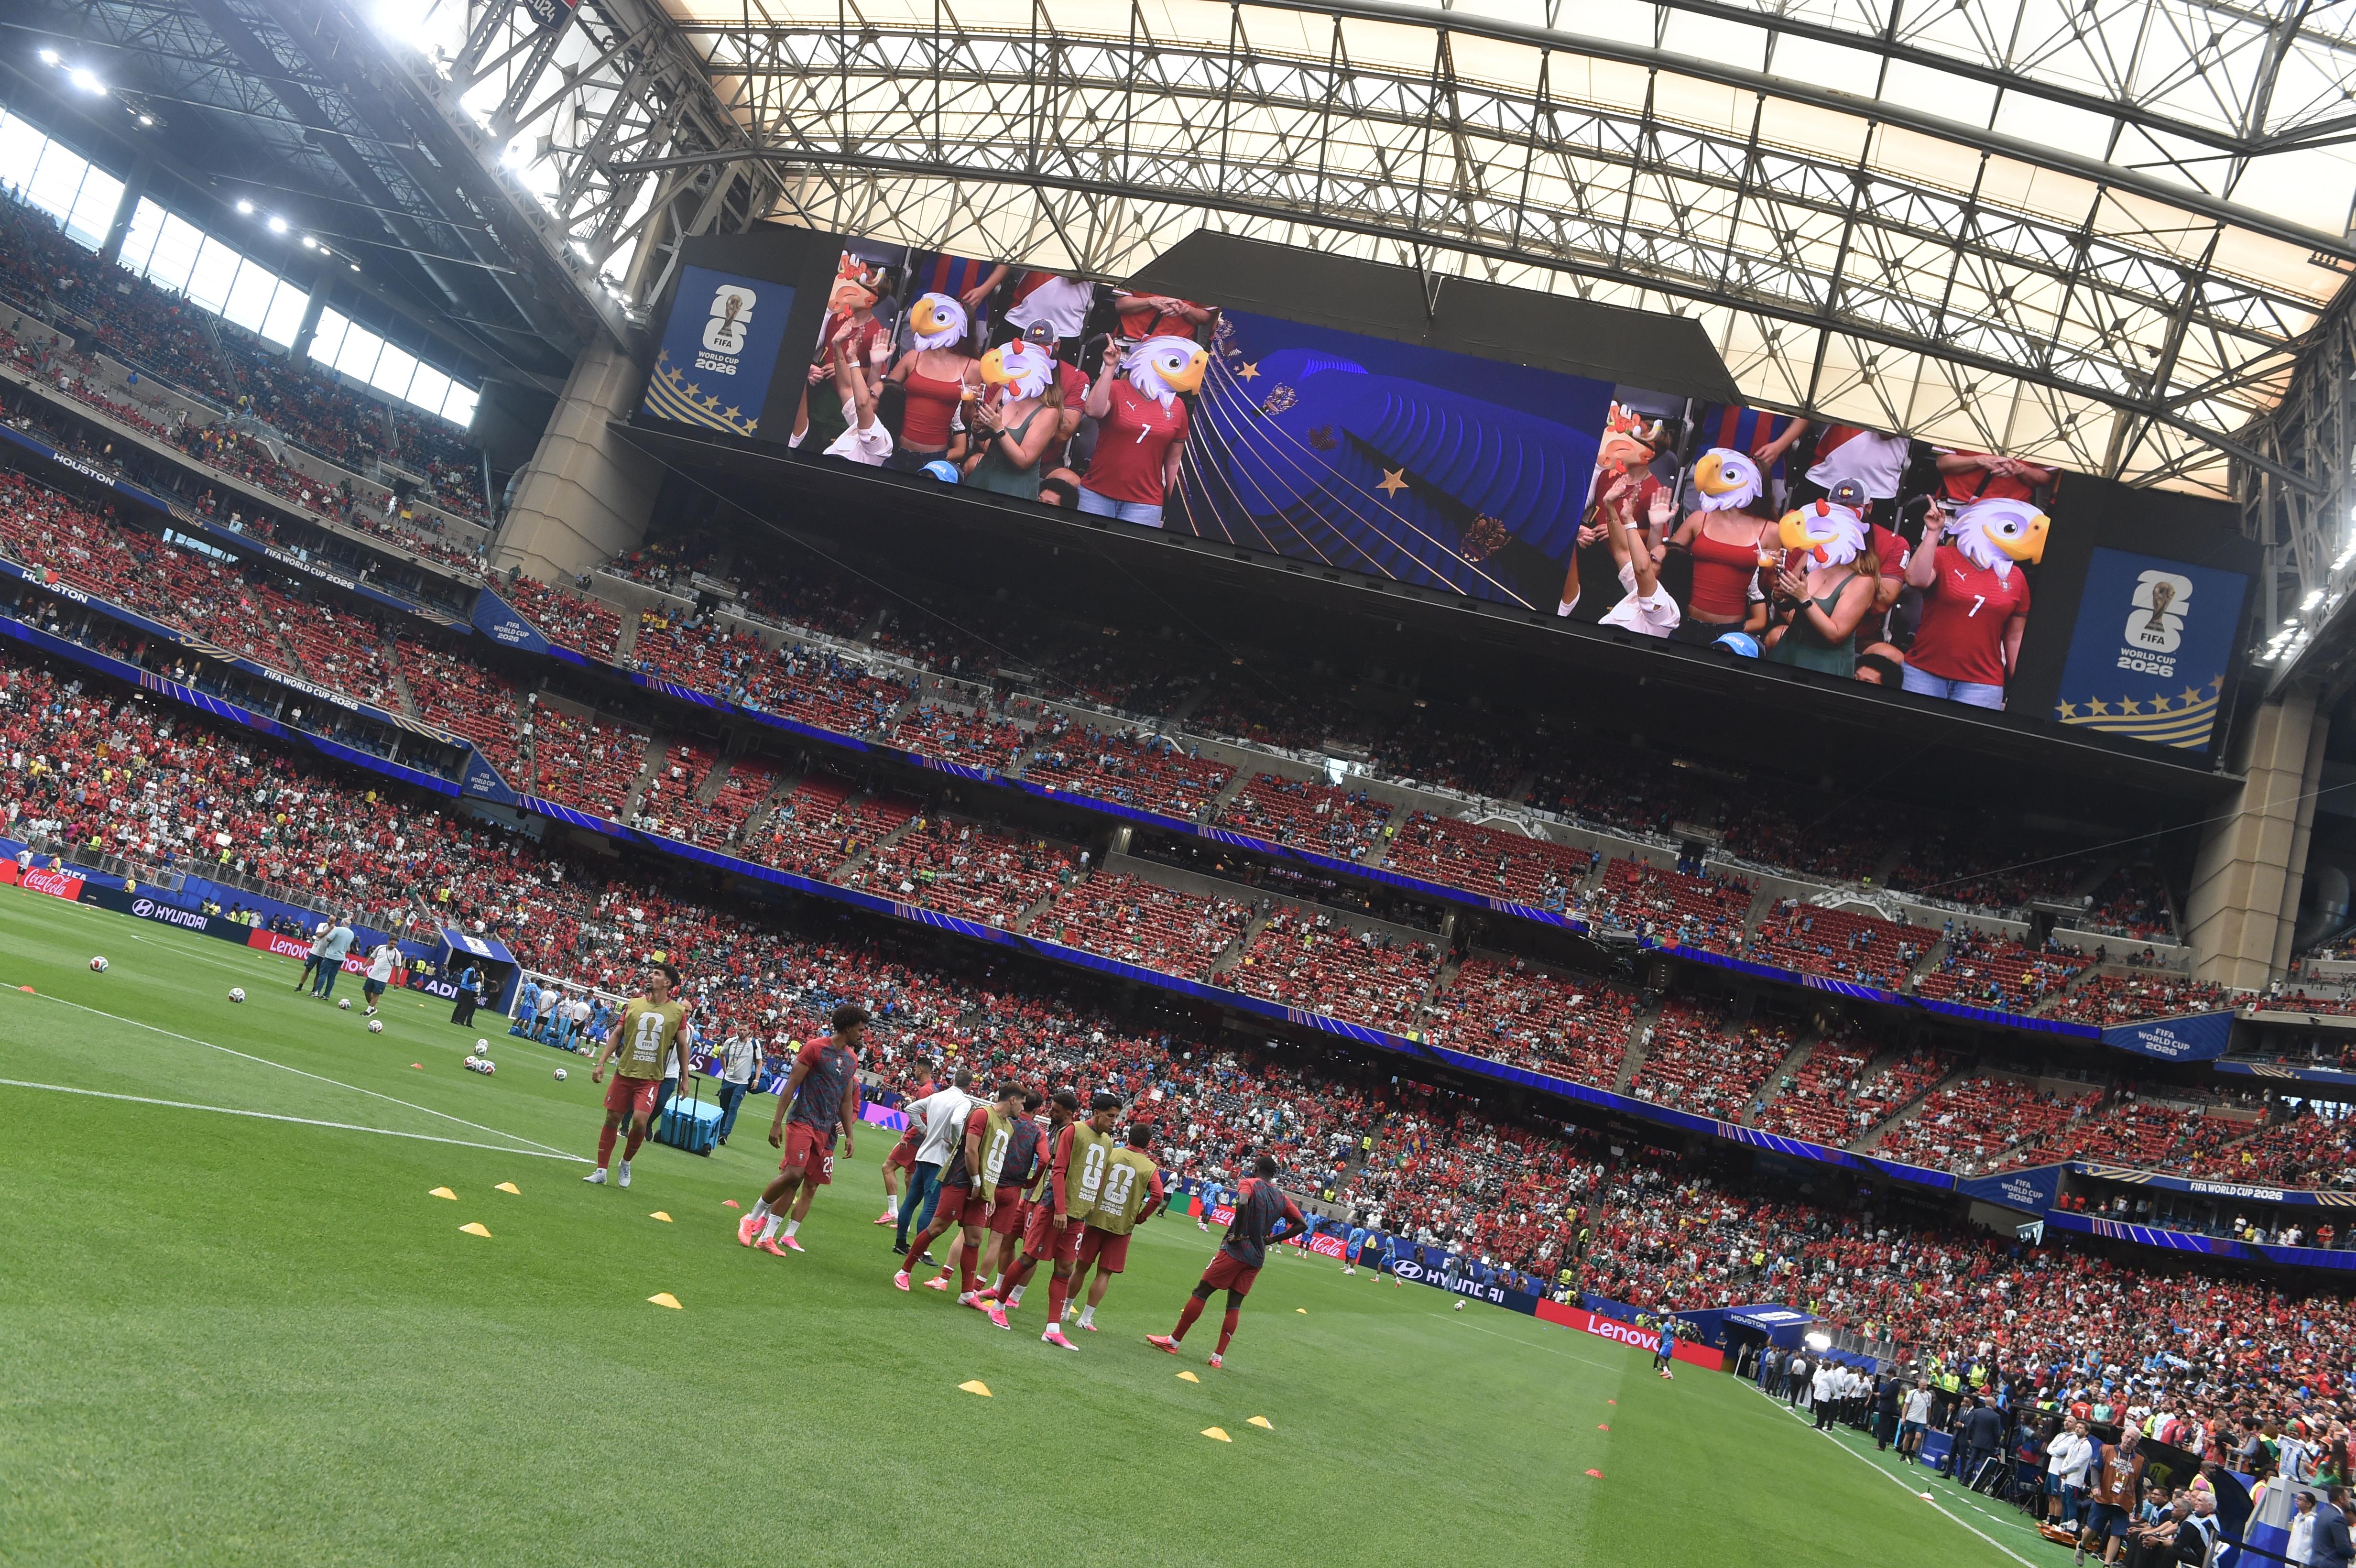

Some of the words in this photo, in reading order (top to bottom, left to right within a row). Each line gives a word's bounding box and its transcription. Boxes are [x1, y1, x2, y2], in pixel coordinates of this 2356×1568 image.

[528, 0, 556, 23] 024
[714, 338, 731, 348] FIFA
[698, 350, 724, 361] WORLD
[724, 357, 739, 365] CUP
[695, 358, 737, 375] 2026
[1135, 423, 1152, 444] 7
[53, 452, 115, 487] HOUSTON
[264, 548, 281, 560] FIFA
[283, 553, 310, 571] WORLD
[310, 567, 326, 577] CUP
[326, 574, 355, 589] 2026
[1968, 594, 1985, 617] 7
[494, 625, 516, 636] WORLD
[506, 621, 519, 629] FIFA
[497, 633, 519, 642] 2026
[2140, 632, 2164, 645] FIFA
[2121, 647, 2155, 661] WORLD
[2156, 655, 2176, 665] CUP
[2117, 656, 2174, 677] 2026
[263, 670, 282, 682] FIFA
[283, 676, 313, 693] WORLD
[313, 688, 330, 699] CUP
[330, 695, 359, 711] 2026
[471, 776, 486, 785] WORLD
[23, 869, 72, 896] Coca-Cola
[154, 905, 208, 930] HYUNDAI
[425, 980, 458, 999] ADI
[2138, 1031, 2171, 1045] WORLD
[2171, 1040, 2190, 1051] CUP
[2155, 1028, 2175, 1039] FIFA
[2145, 1042, 2178, 1056] 2026
[633, 1054, 656, 1063] 2026
[648, 1086, 657, 1102] 4
[2001, 1182, 2028, 1195] WORLD
[2028, 1190, 2043, 1199] CUP
[2015, 1178, 2030, 1189] FIFA
[2190, 1182, 2206, 1192] FIFA
[2208, 1184, 2236, 1195] WORLD
[2236, 1187, 2253, 1197] CUP
[2253, 1189, 2283, 1201] 2026
[2007, 1192, 2033, 1204] 2026
[1099, 1205, 1122, 1216] 2026
[1731, 1313, 1767, 1329] HOUSTON
